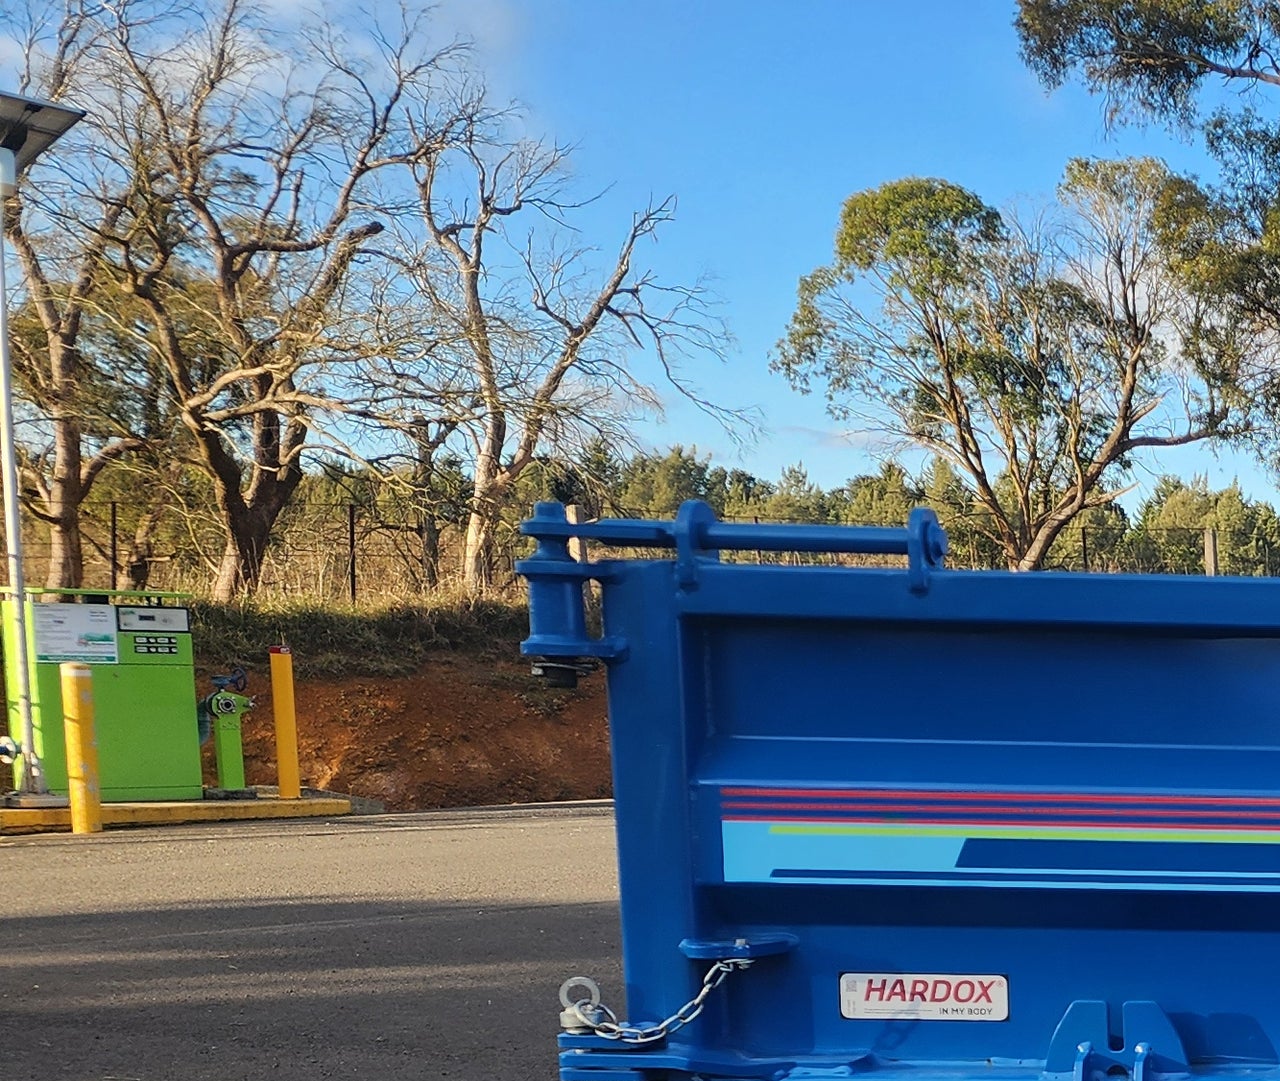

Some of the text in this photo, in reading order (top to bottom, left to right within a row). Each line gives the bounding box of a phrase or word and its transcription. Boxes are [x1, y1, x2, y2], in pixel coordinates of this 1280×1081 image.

[938, 1007, 949, 1016] IN
[951, 1007, 965, 1016] MY
[967, 1007, 993, 1016] BODY
